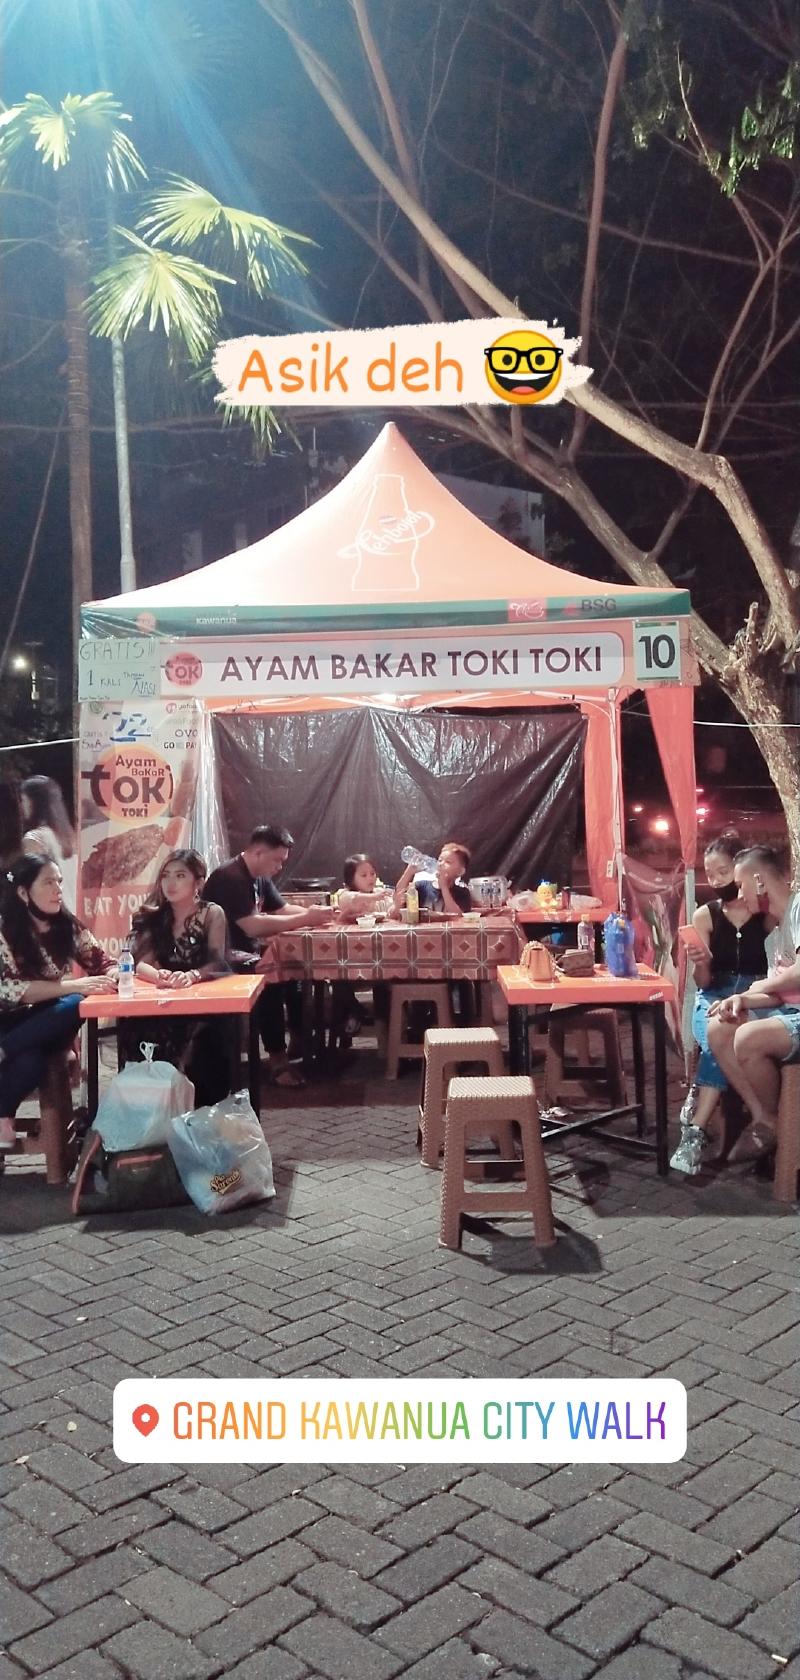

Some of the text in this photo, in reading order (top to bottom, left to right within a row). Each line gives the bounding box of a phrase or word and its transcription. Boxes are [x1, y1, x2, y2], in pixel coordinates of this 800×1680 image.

[581, 598, 617, 611] BSG
[638, 634, 676, 669] 10
[220, 647, 602, 682] AYAM BAKAR TOKI TOKI
[115, 755, 156, 768] Ayam
[84, 896, 112, 917] EAT
